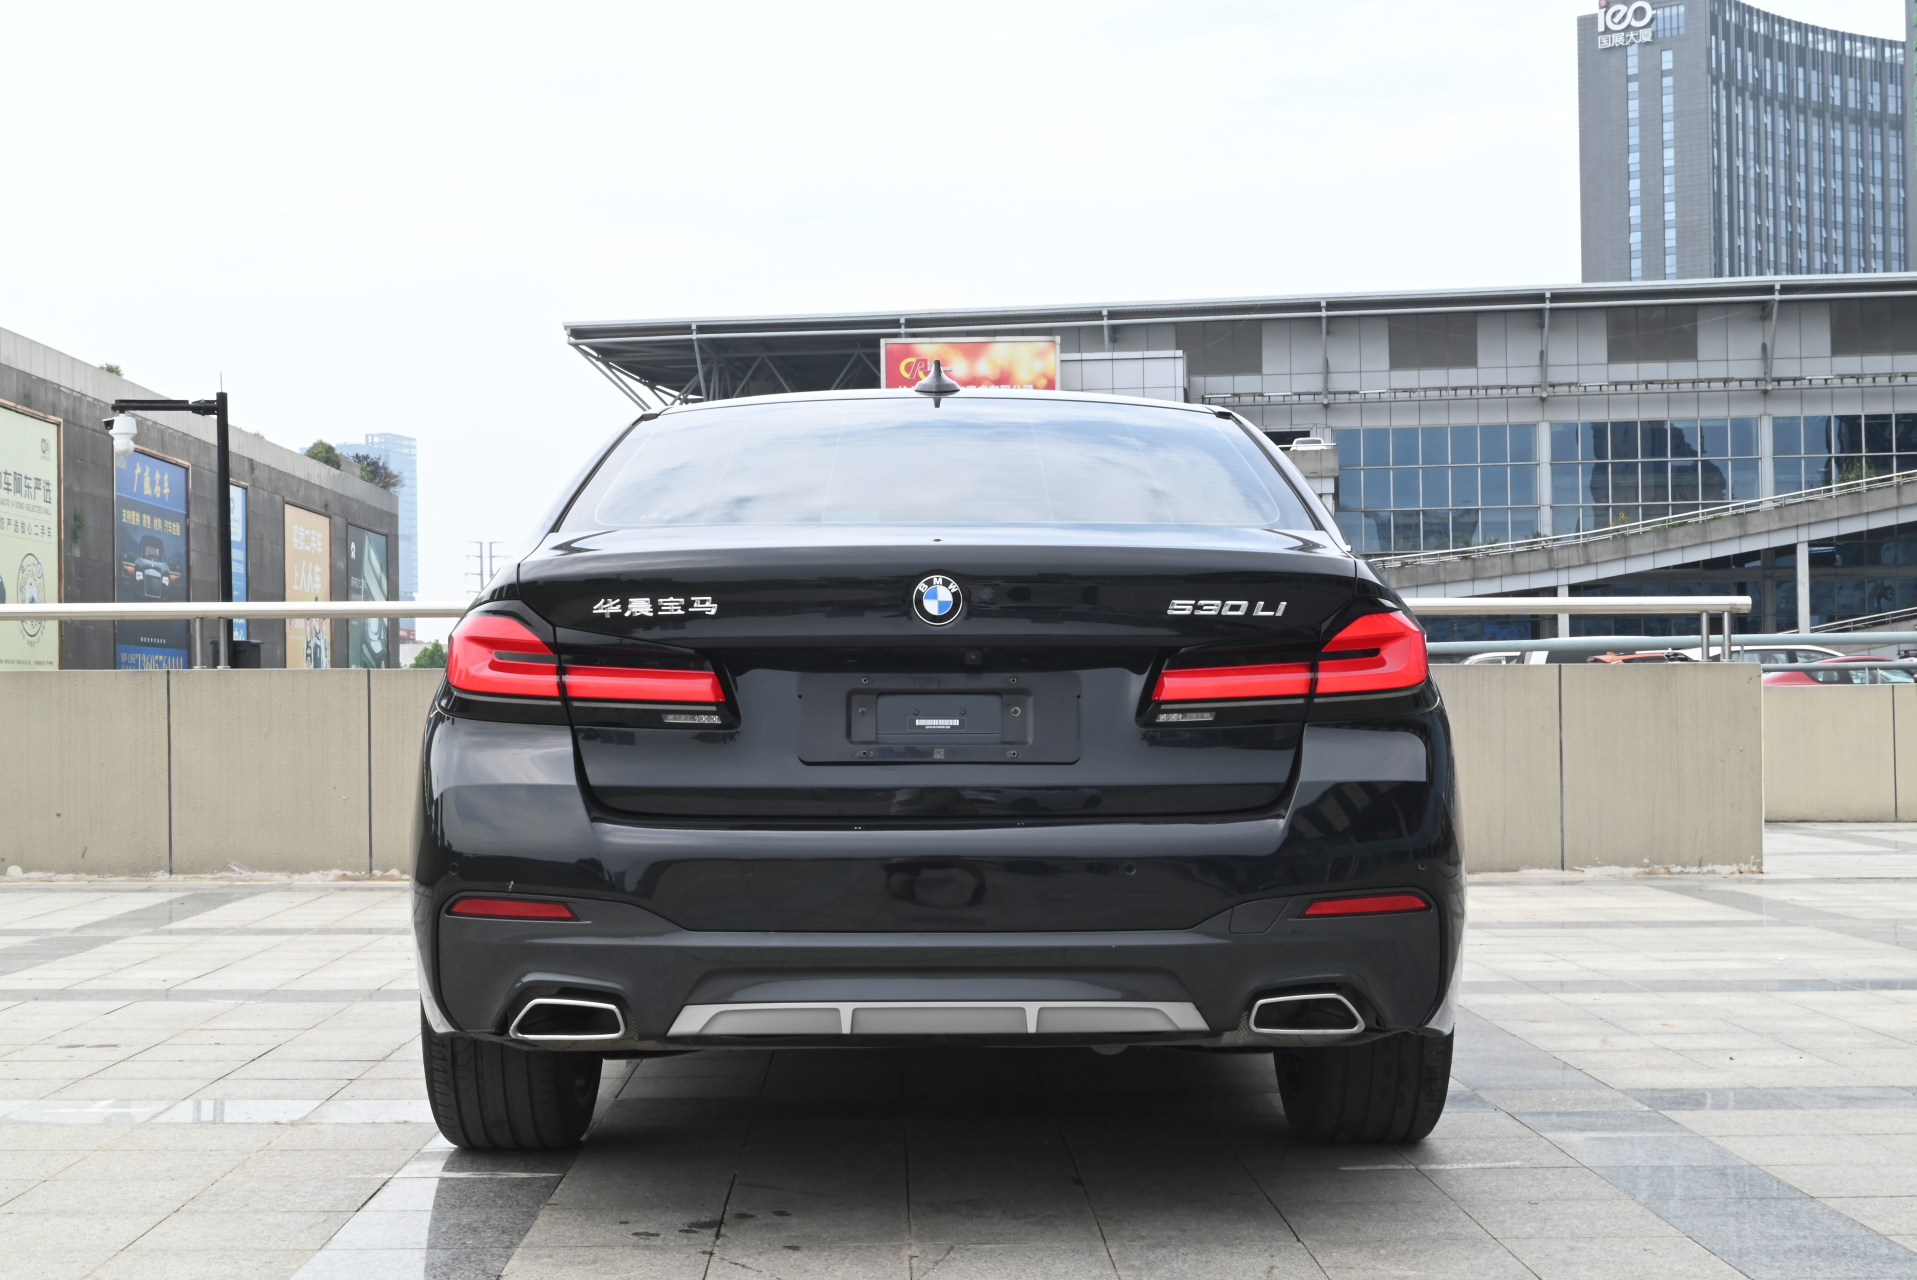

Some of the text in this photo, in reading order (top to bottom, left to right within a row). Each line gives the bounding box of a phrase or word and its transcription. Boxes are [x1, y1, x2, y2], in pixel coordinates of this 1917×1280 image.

[1598, 28, 1653, 49] 国展大厦
[0, 469, 52, 504] 车阿东严选
[292, 524, 323, 556] 买卖二手车
[293, 560, 322, 594] 上人人车
[918, 577, 959, 593] BMW
[593, 597, 718, 618] 华晨宝马
[911, 676, 934, 687] TOP
